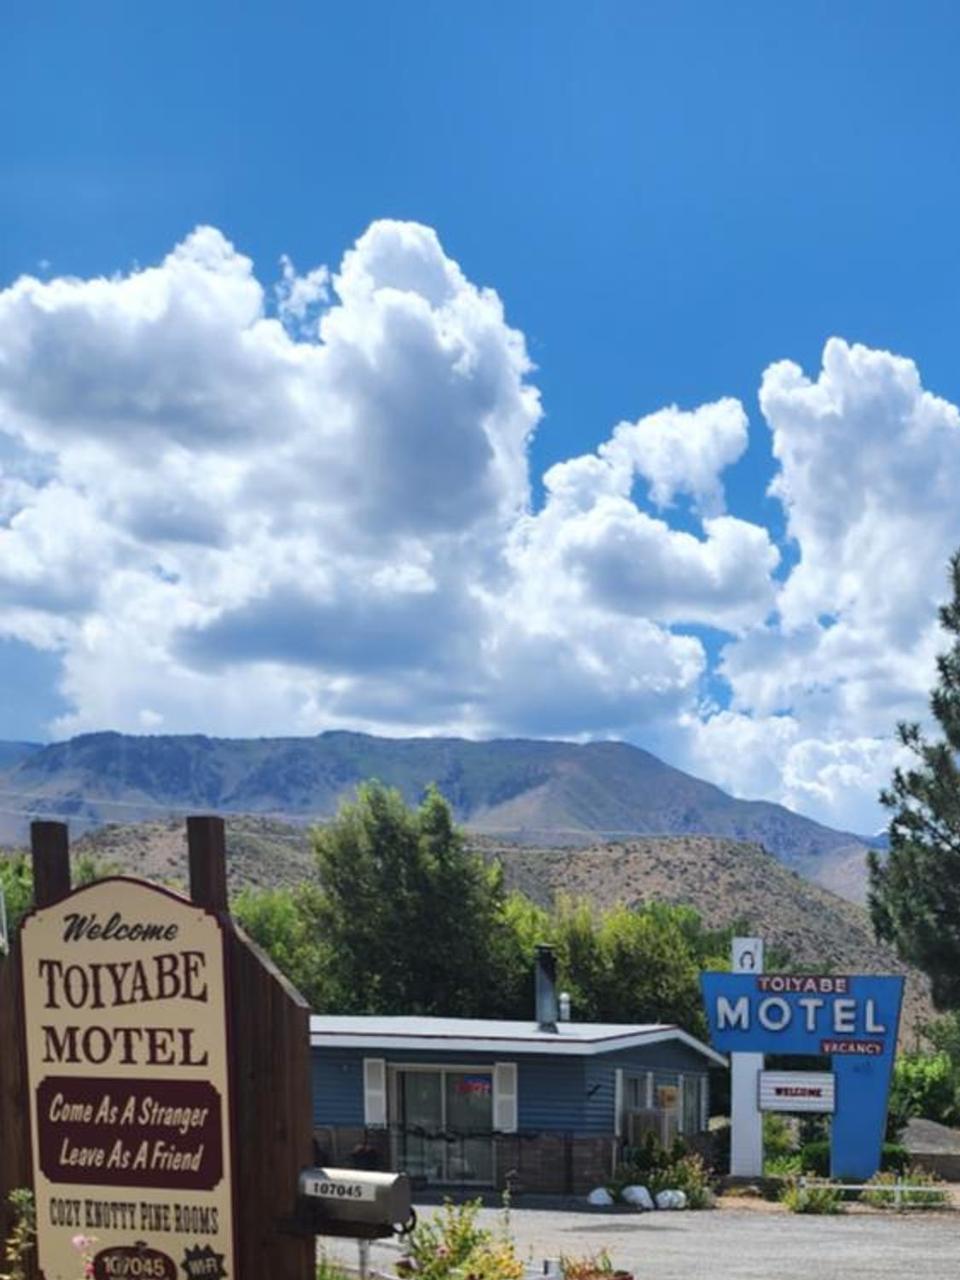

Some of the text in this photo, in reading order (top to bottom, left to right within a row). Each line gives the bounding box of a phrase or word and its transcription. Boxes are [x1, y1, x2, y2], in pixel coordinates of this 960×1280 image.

[63, 912, 178, 943] Welcome
[39, 950, 208, 1010] TOIYABE
[759, 977, 847, 992] TOIYABE
[717, 997, 885, 1033] MOTEL
[41, 1024, 209, 1066] MOTEL
[823, 1043, 881, 1054] VACANCY
[775, 1087, 822, 1098] WELCOME
[50, 1093, 209, 1135] Come As A Stranger
[59, 1138, 204, 1171] Leave As A Friend
[313, 1182, 362, 1198] 107045
[50, 1198, 219, 1235] COZY KNOTTY PINE ROOMS
